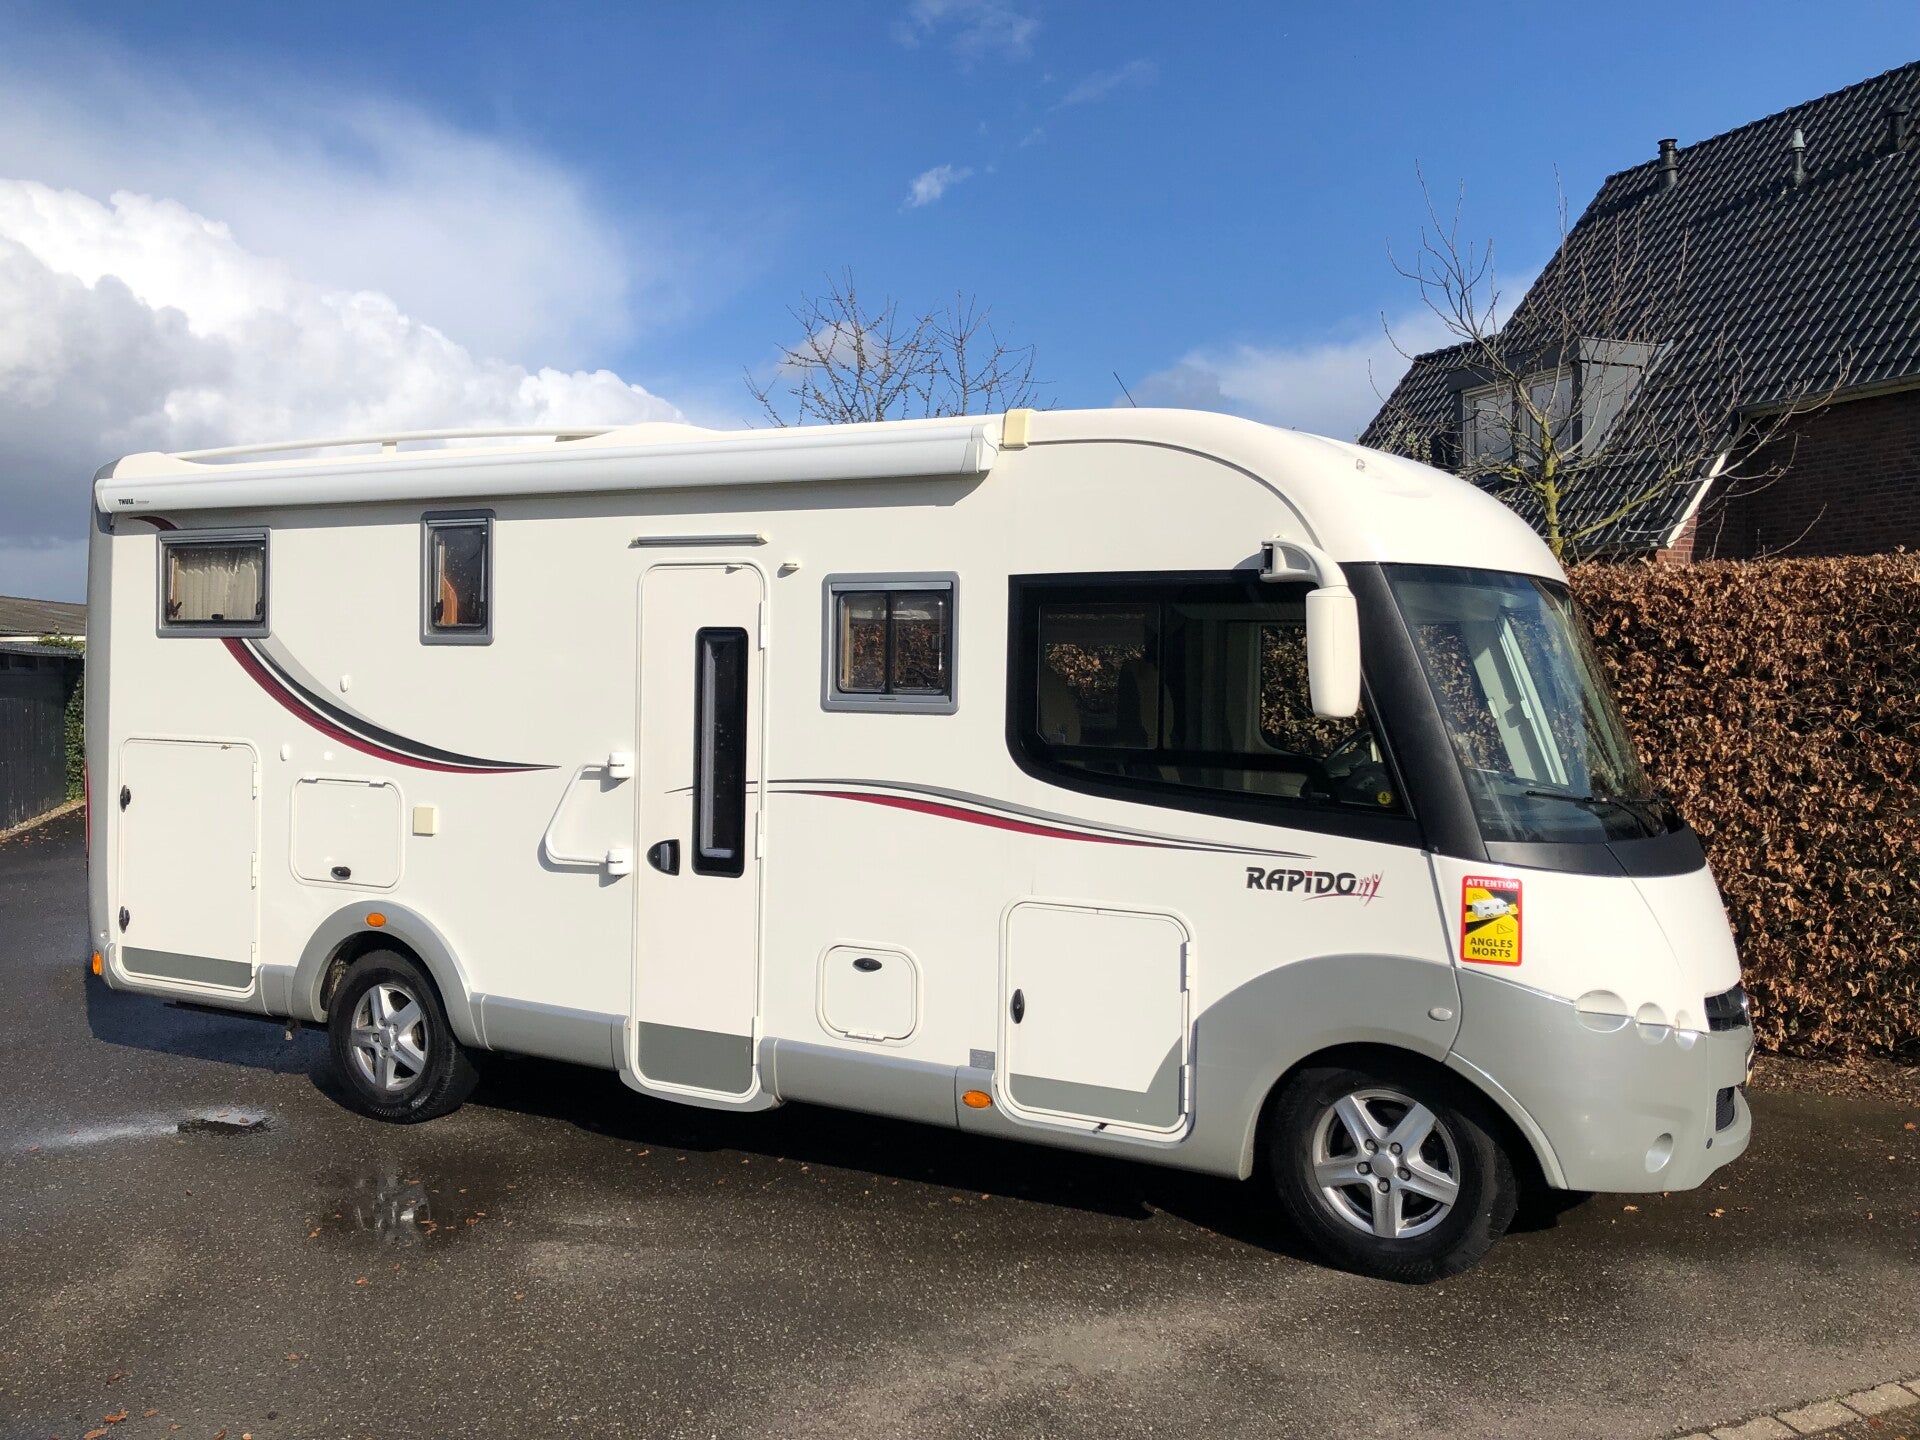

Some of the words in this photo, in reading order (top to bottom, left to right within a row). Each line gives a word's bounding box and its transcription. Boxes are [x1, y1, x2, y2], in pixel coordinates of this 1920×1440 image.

[1466, 878, 1519, 889] ATTENTION
[1470, 937, 1513, 948] ANGLES
[1472, 947, 1511, 957] MORTS
